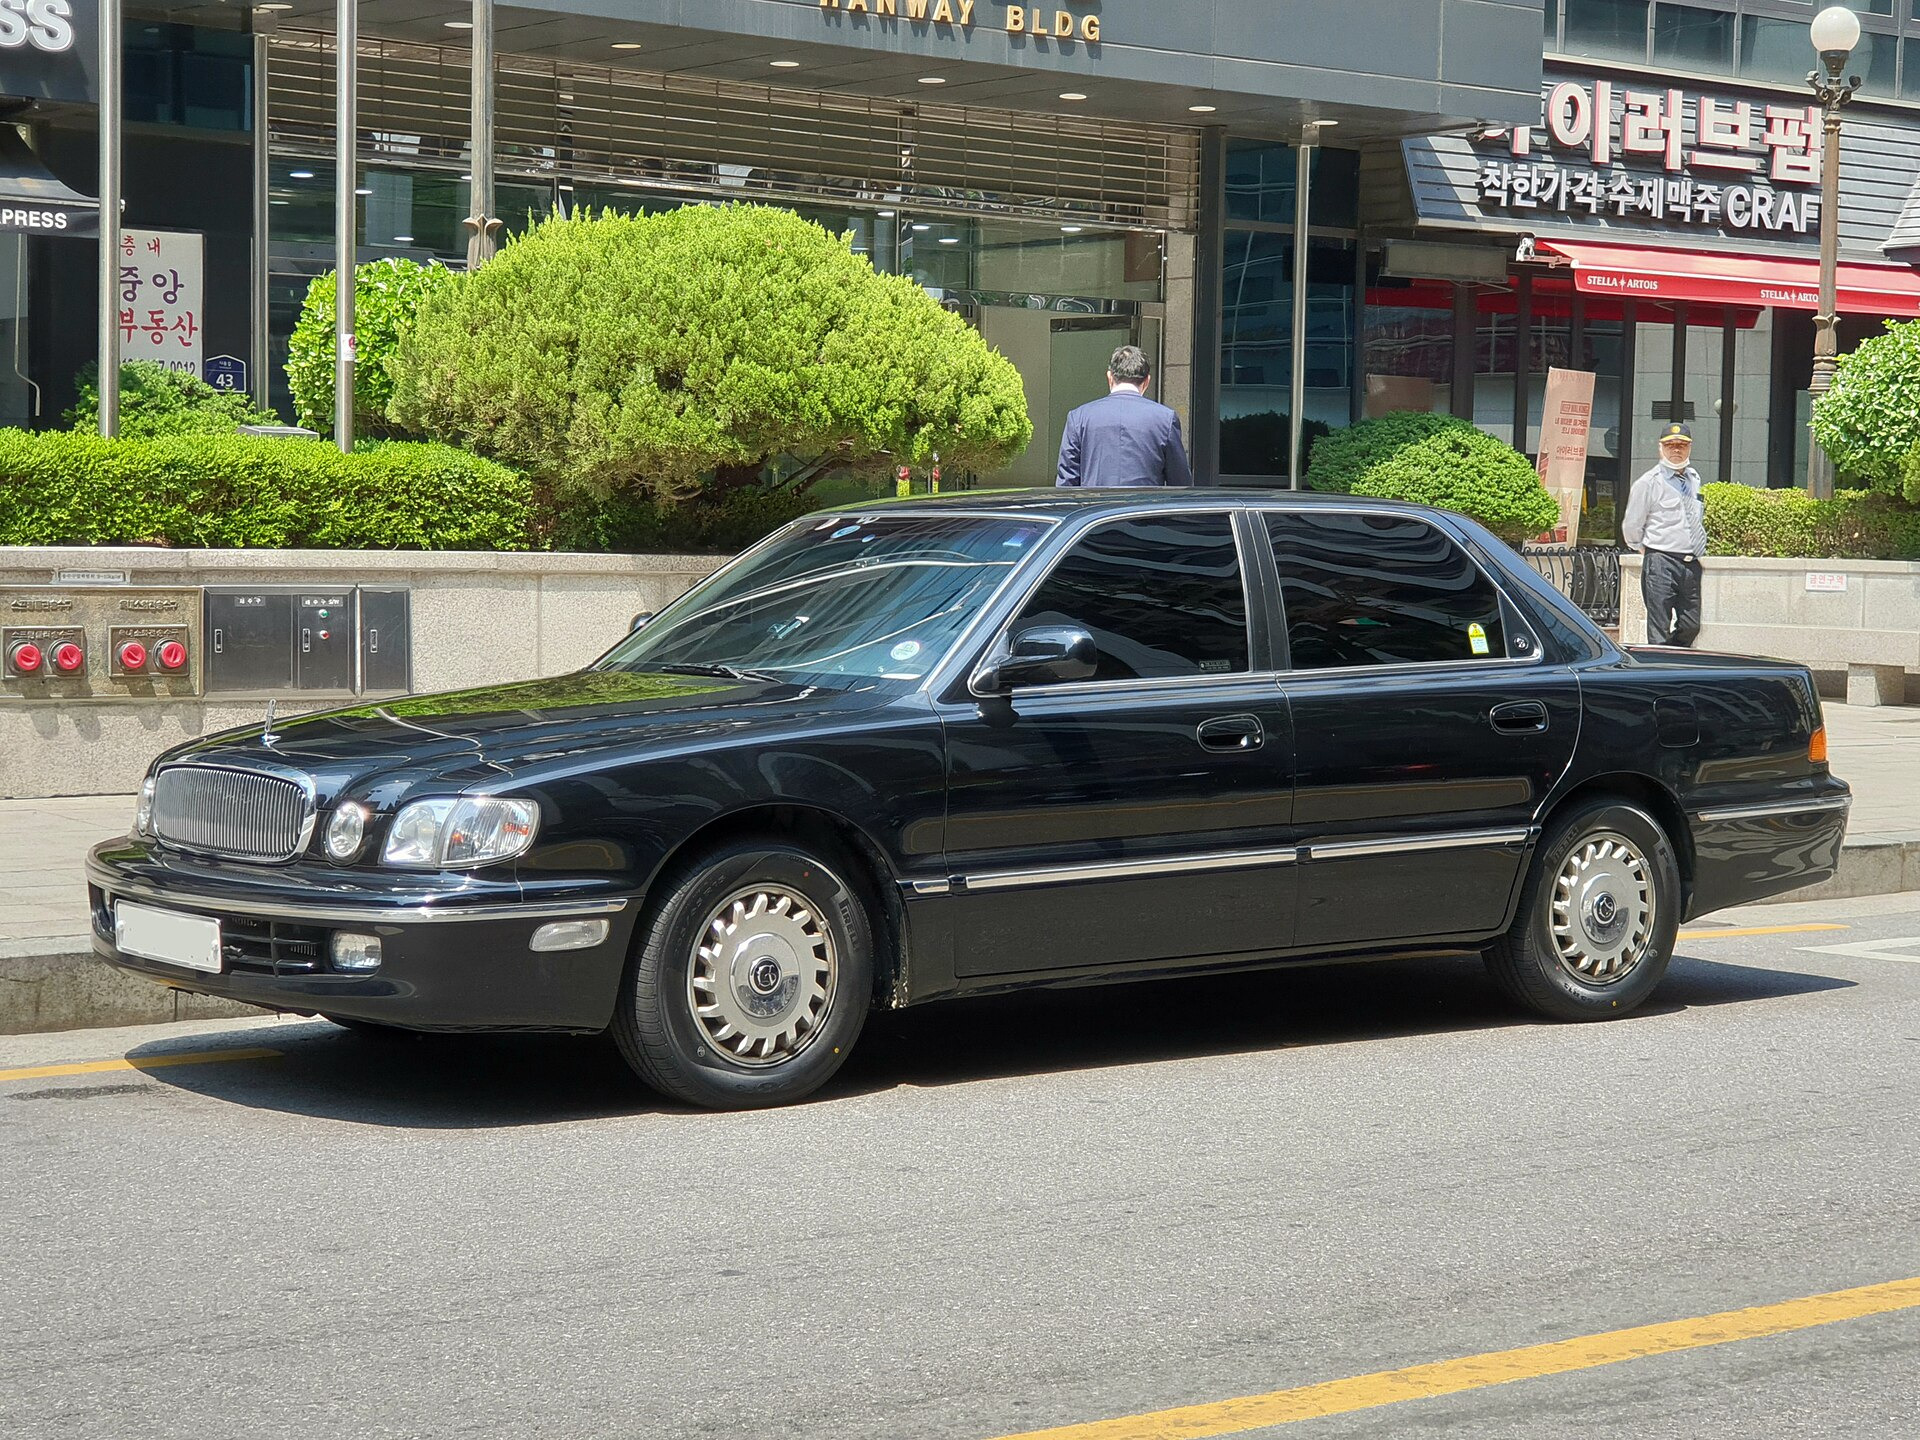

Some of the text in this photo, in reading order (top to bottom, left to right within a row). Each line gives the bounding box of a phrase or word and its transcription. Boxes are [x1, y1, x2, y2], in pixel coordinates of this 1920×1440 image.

[820, 0, 1100, 41] NWAY BLDG
[1484, 80, 1822, 184] 이러브펍
[1482, 161, 1823, 233] 착한가격 수제맥주 CRAF
[0, 208, 67, 228] PRESS
[1587, 275, 1658, 290] STELLA ARTOIS
[1760, 289, 1819, 302] STELLA ARTO
[120, 307, 198, 347] 부동산
[216, 373, 234, 387] 43
[1557, 446, 1584, 456] 아이러브펍
[1810, 574, 1844, 584] 금연구역
